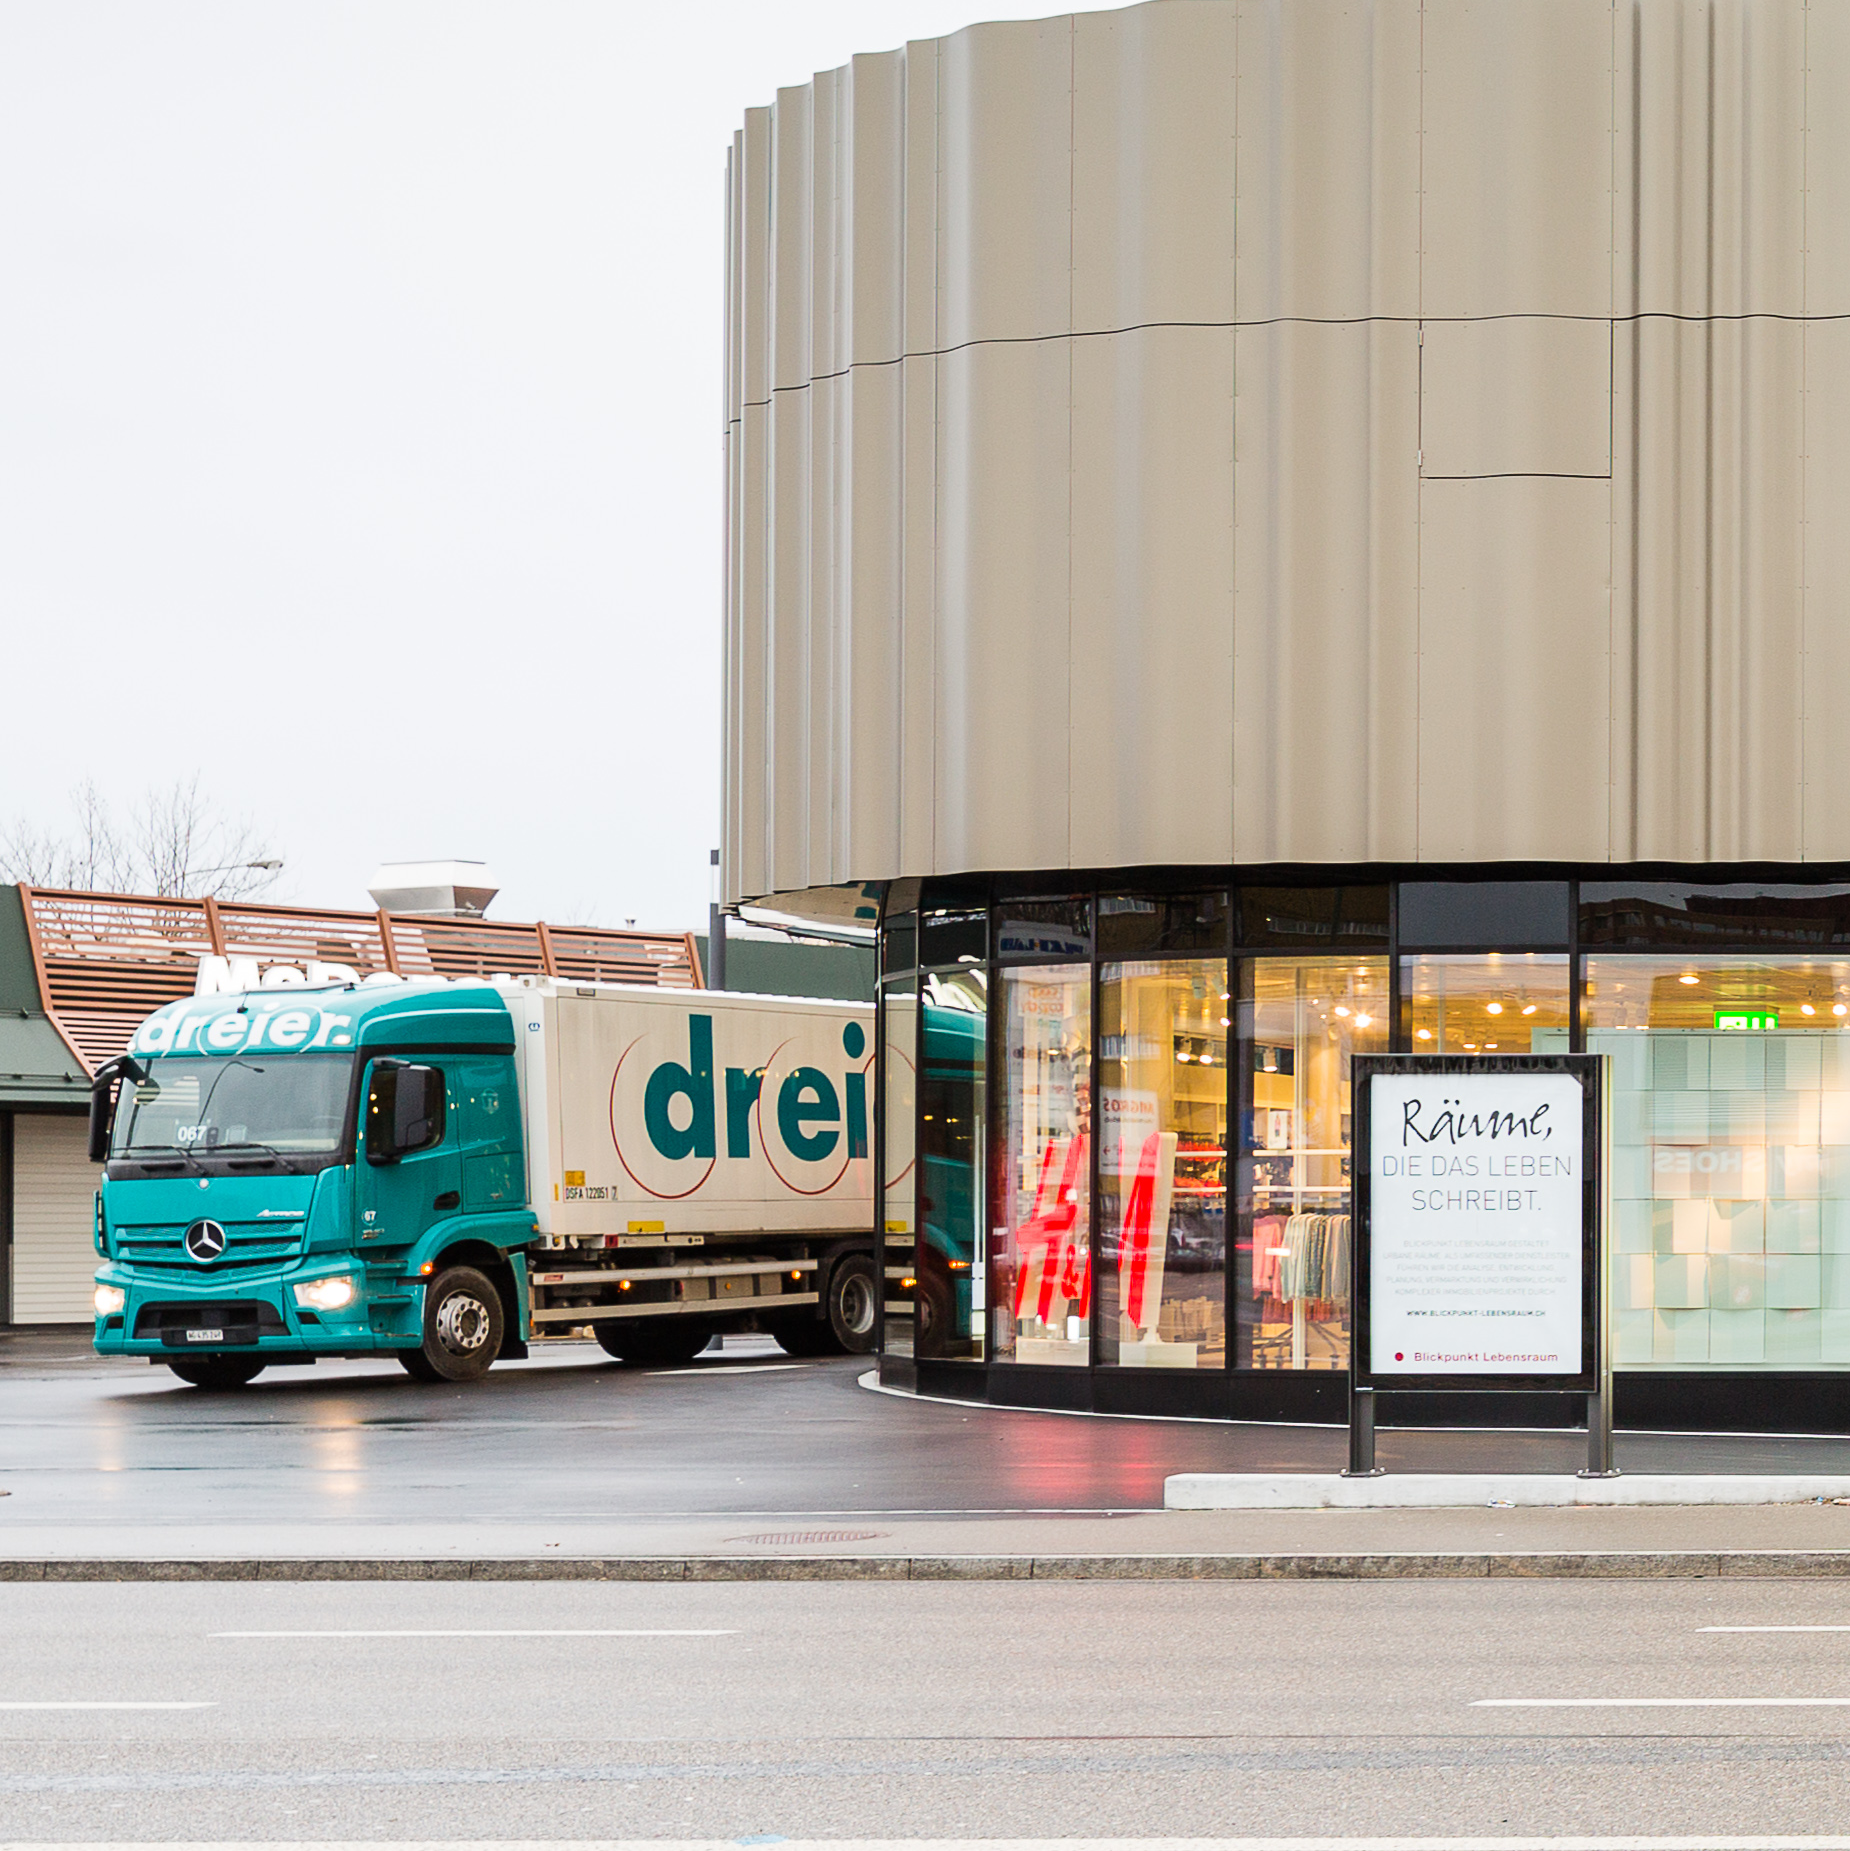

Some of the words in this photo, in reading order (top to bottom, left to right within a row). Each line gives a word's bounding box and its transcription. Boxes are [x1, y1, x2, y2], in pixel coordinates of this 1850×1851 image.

[178, 1125, 207, 1142] 067
[1402, 1098, 1552, 1147] Räume,
[1382, 1155, 1422, 1177] DIE
[1432, 1155, 1479, 1177] DAS
[1489, 1155, 1571, 1177] LEBEN
[1411, 1189, 1542, 1211] SCHREIBT.
[1413, 1352, 1479, 1363] Blickpunkt
[1483, 1352, 1558, 1362] Lebensraum
